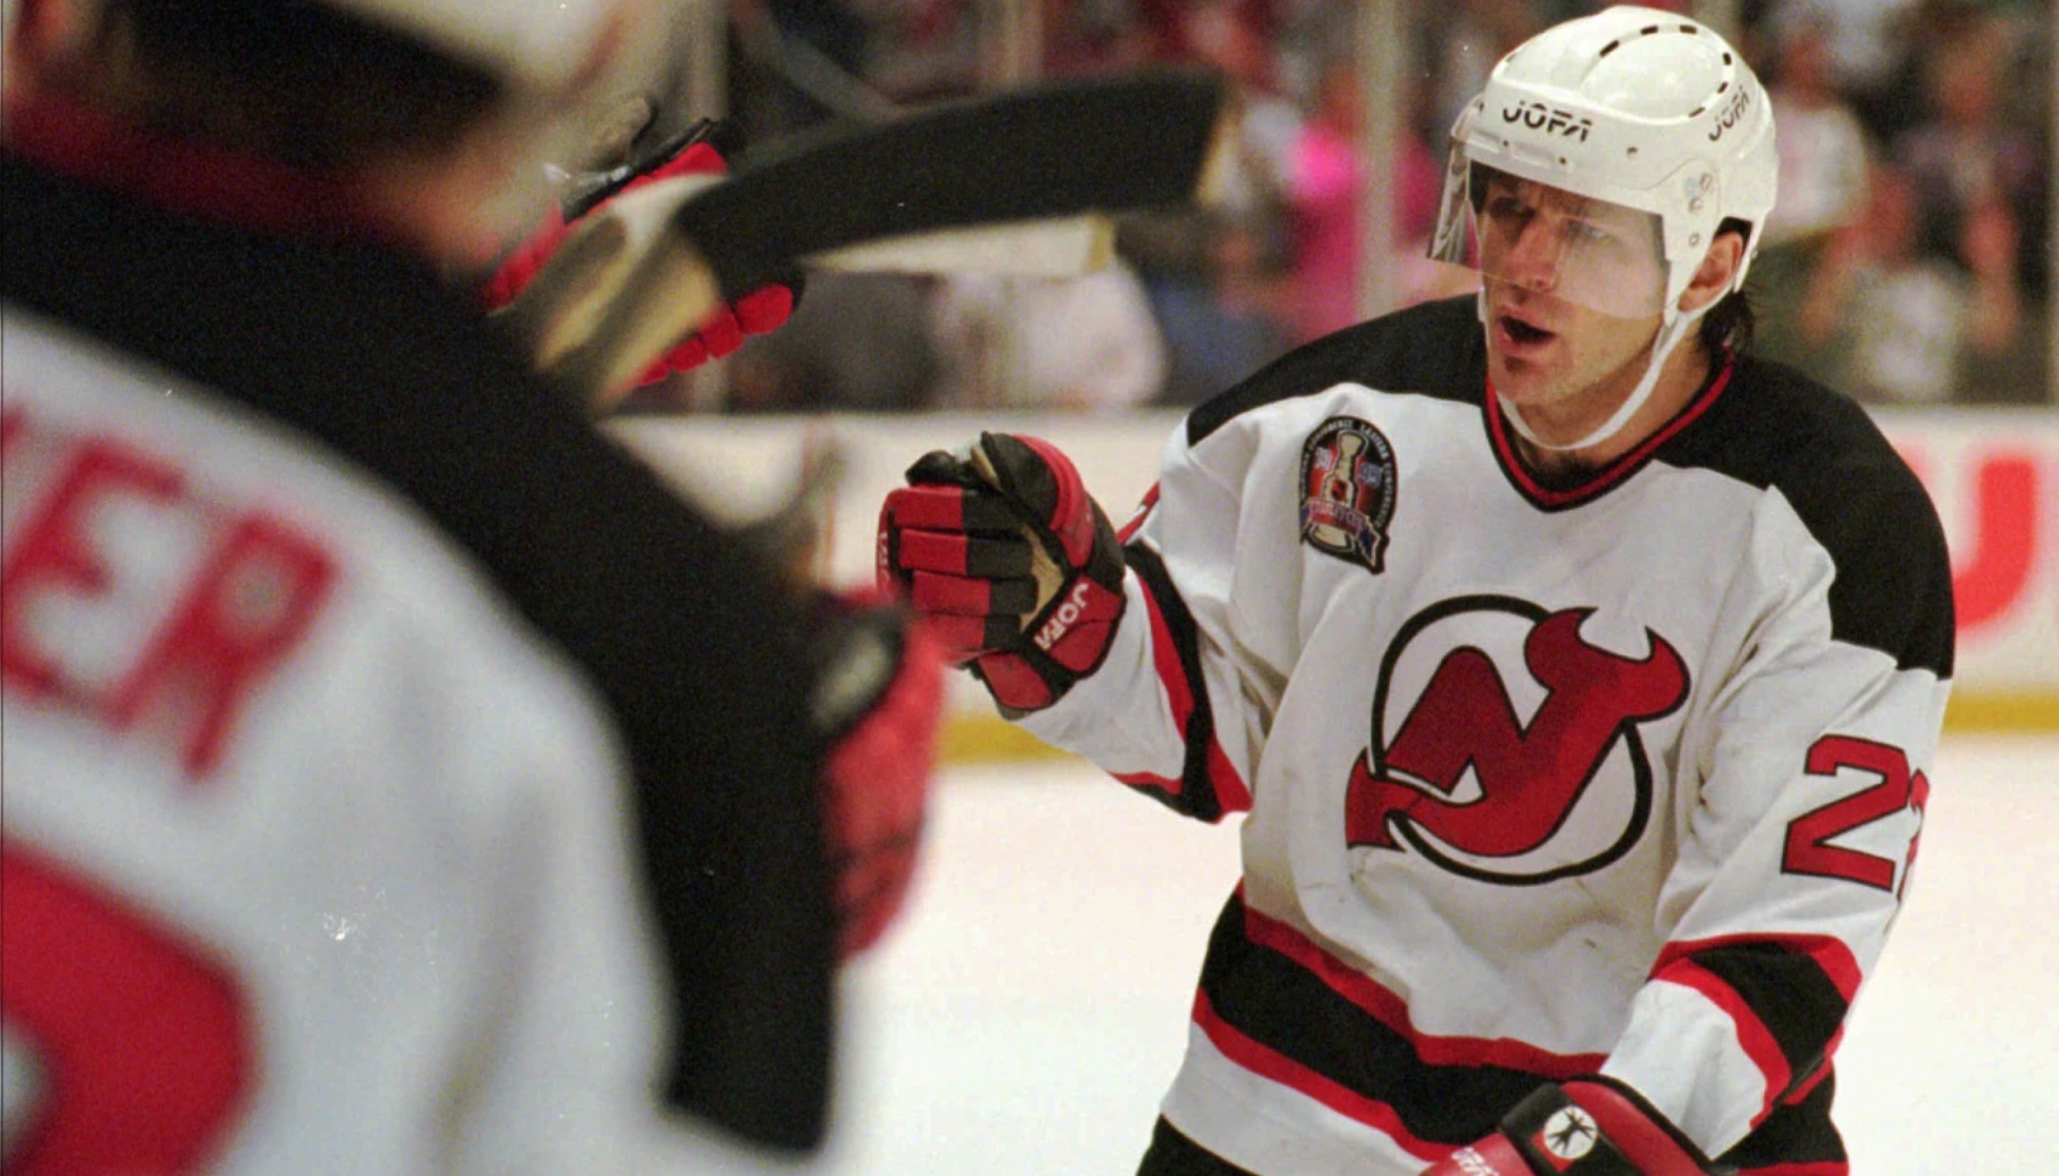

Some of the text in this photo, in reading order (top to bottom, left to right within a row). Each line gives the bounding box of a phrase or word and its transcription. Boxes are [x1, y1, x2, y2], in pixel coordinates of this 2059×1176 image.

[1503, 101, 1592, 143] JOFA
[1708, 86, 1750, 142] JOFA
[2, 405, 342, 785] ER
[1034, 582, 1090, 650] JOFA
[1779, 733, 1930, 904] 2
